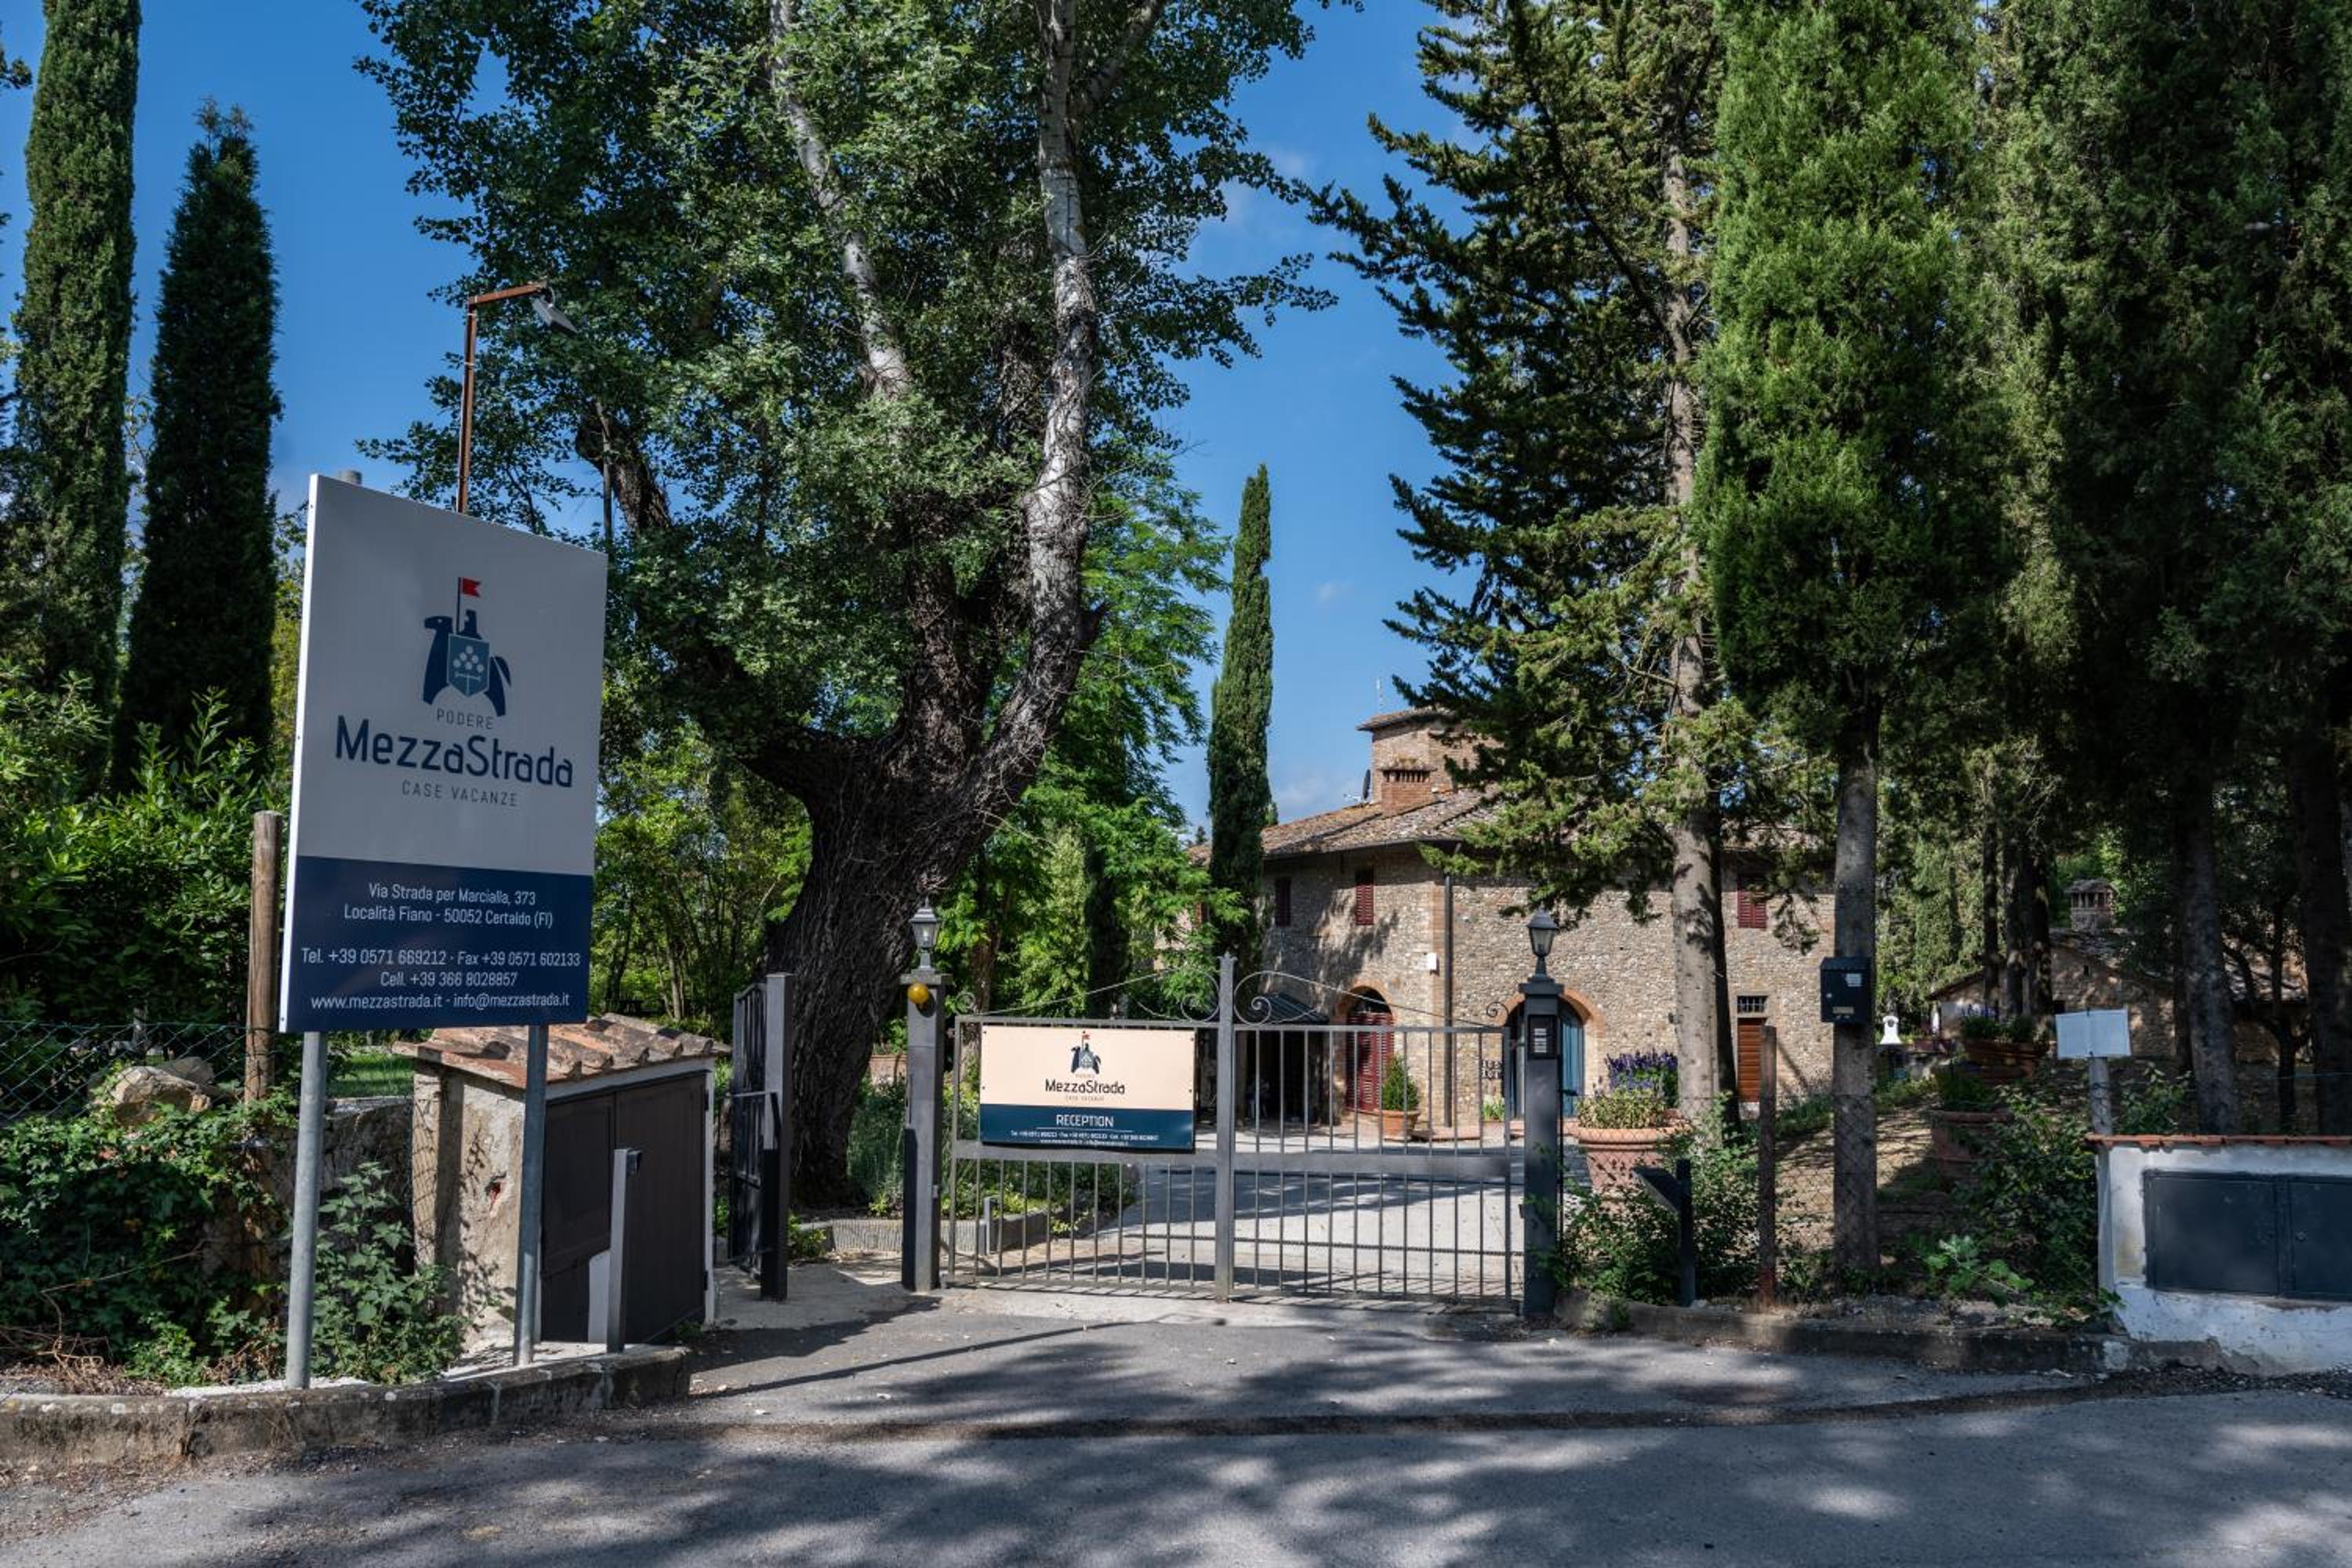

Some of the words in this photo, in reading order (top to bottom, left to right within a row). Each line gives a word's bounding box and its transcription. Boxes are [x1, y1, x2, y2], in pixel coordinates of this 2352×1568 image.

[437, 708, 494, 729] PODERE
[336, 714, 573, 788] MezzaStrada
[402, 780, 443, 800] CASE
[452, 787, 518, 807] VACANZE
[368, 883, 388, 898] Via
[391, 884, 431, 901] Strada
[436, 888, 455, 903] per
[459, 887, 511, 906] Marcialla,
[514, 891, 535, 905] 373
[344, 903, 395, 920] Località
[400, 906, 432, 922] Fiano
[445, 908, 482, 924] 50052
[485, 910, 531, 926] Certaldo
[534, 911, 553, 928] (FI)
[301, 947, 324, 964] Tel.
[328, 948, 357, 964] +39
[360, 949, 394, 965] 0571
[397, 949, 446, 965] 669212
[457, 951, 480, 966] Fax
[481, 951, 506, 966] +39
[508, 952, 537, 967] 0571
[540, 953, 581, 967] 602133
[379, 971, 406, 987] Cell.
[410, 972, 436, 987] +39
[438, 972, 462, 987] 366
[465, 971, 518, 987] 8028857
[310, 993, 443, 1009] www.mezzastrada.it
[453, 992, 570, 1011] info@mezzastrada.it
[1045, 1078, 1126, 1094] MezzaStrada
[1056, 1114, 1114, 1127] RECEPTION
